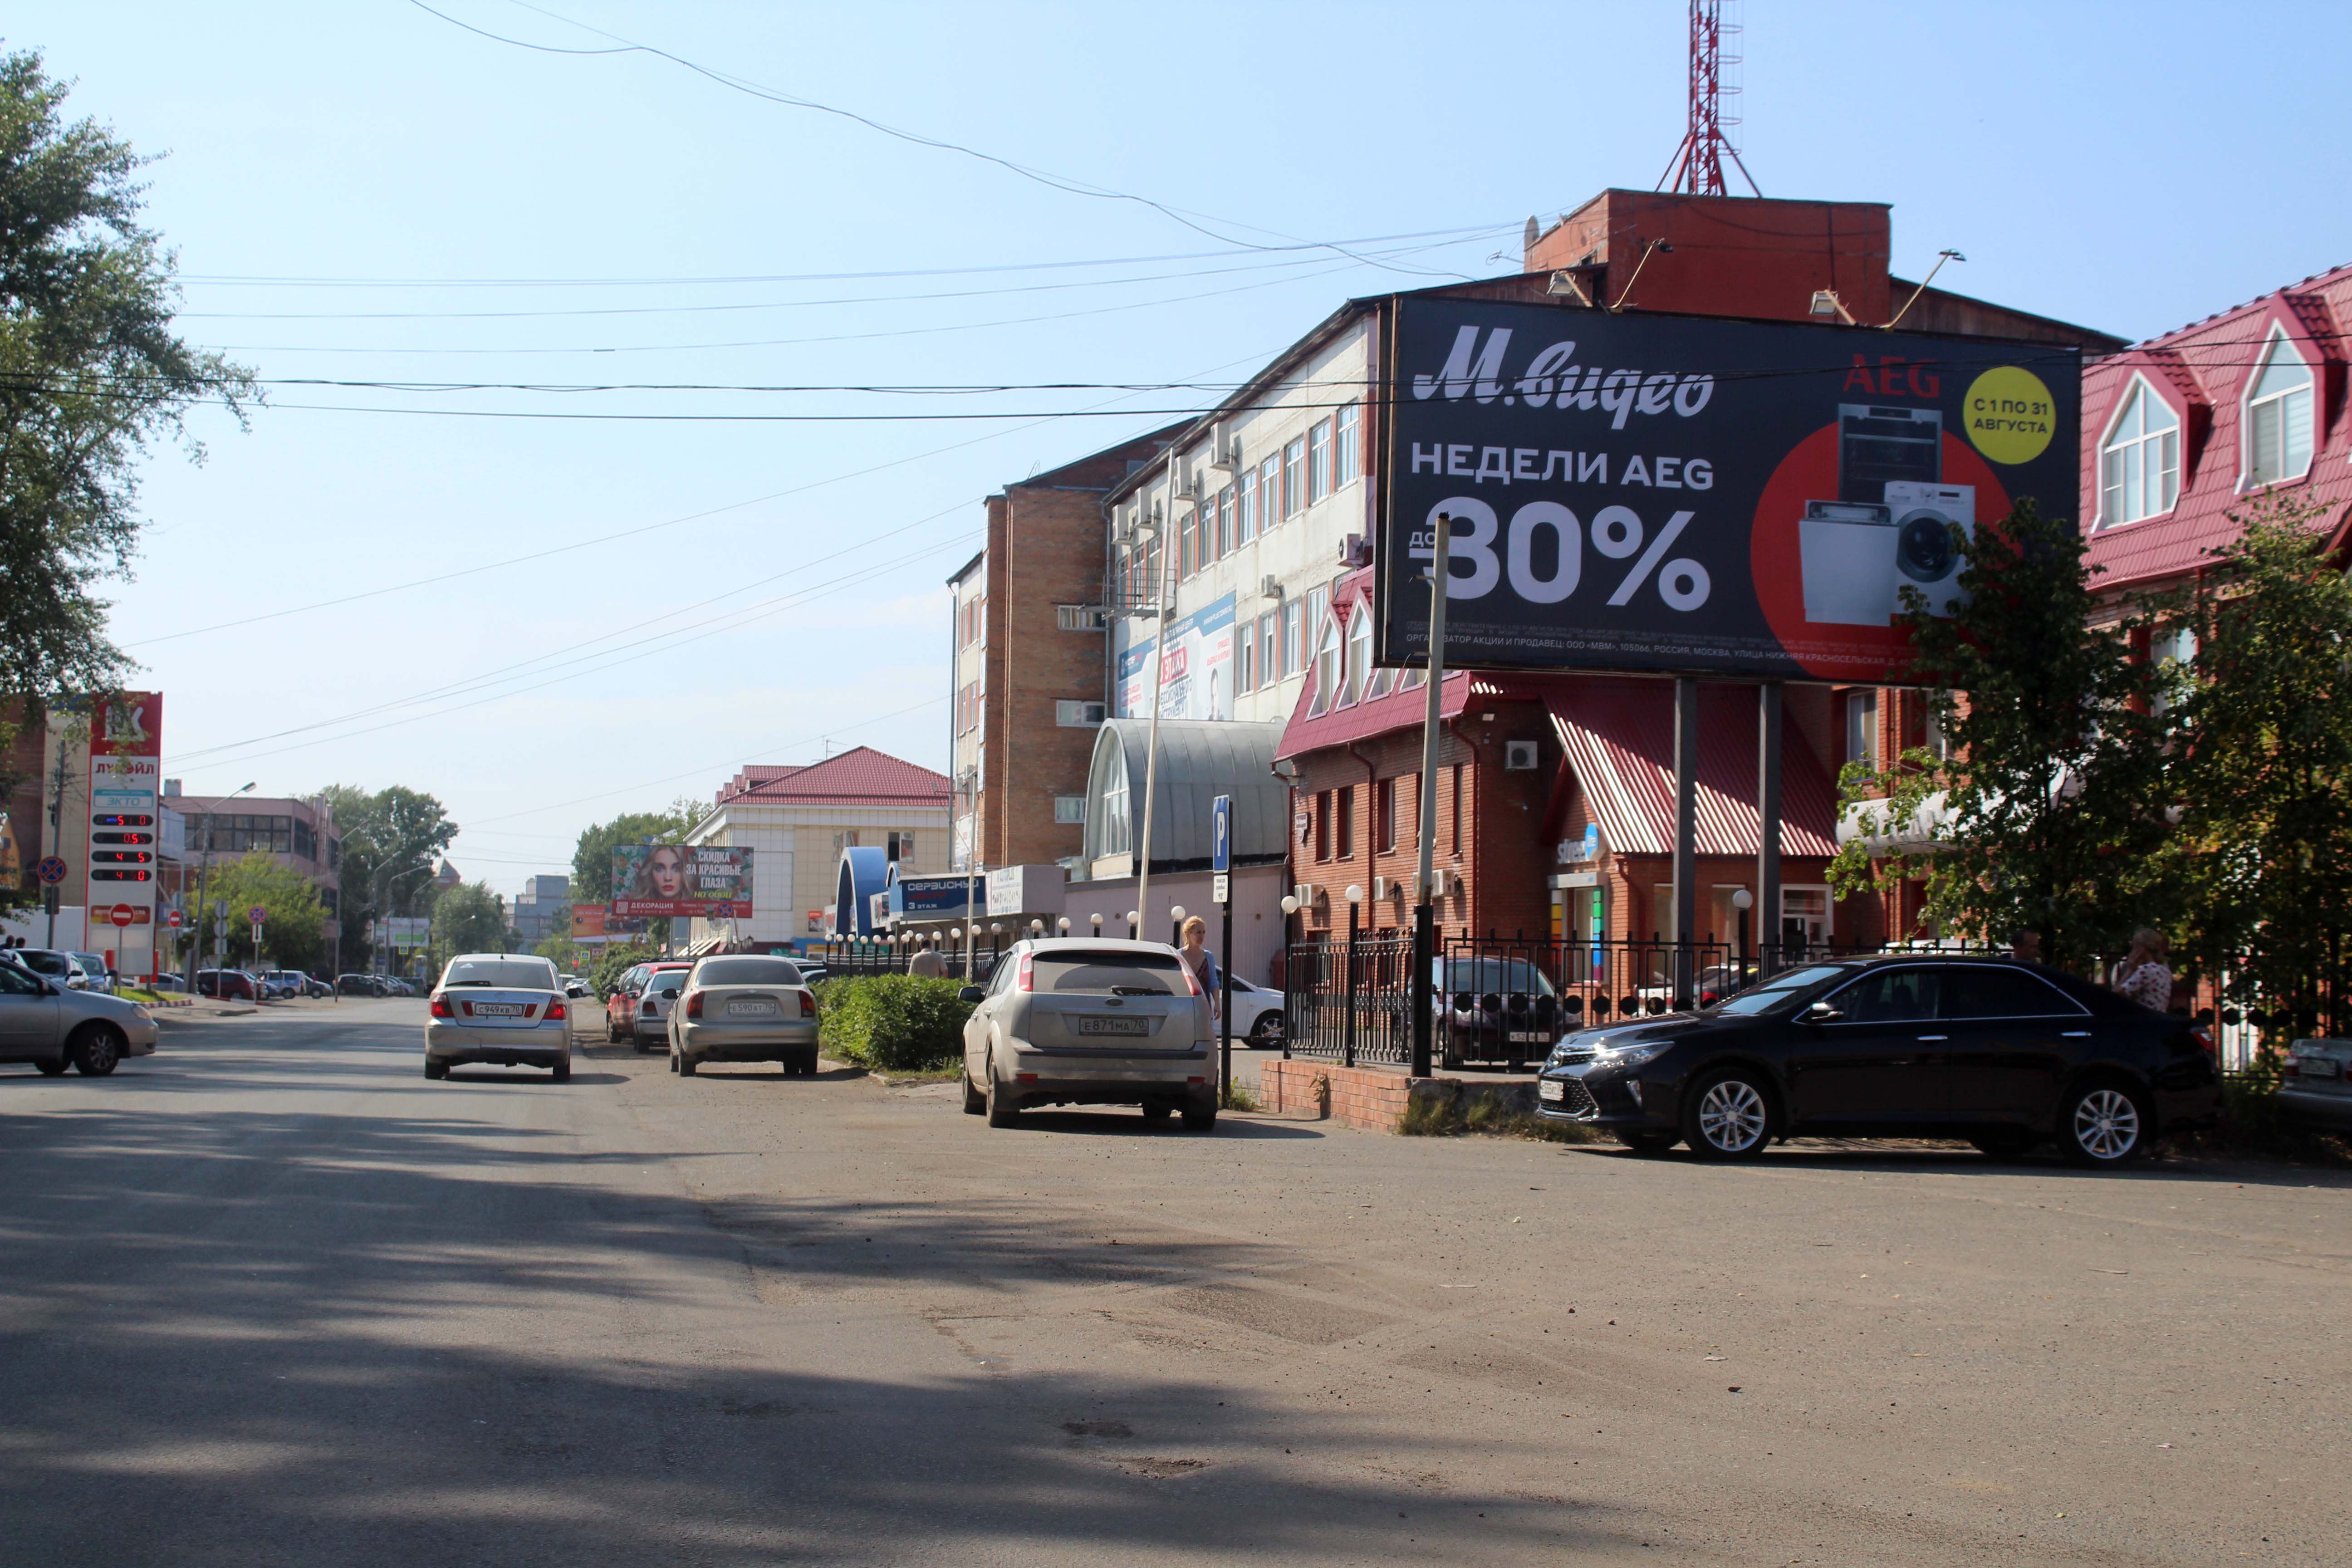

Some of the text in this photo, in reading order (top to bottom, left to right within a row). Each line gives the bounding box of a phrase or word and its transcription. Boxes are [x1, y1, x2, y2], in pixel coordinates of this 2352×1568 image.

[1842, 353, 1940, 398] AEG
[1974, 398, 2048, 416] С 1 ПО 31
[1974, 418, 2048, 435] АВГУСТА
[1412, 442, 1714, 490] НЕДЕЛИ AEG
[1423, 496, 1711, 612] 30%
[1406, 634, 1470, 643] ОРГАЗАТОР
[1473, 636, 1503, 646] АКЦИИ
[1514, 638, 1564, 648] ПРОДАВЕЦ:
[1566, 640, 1585, 649] ООО
[1654, 645, 1691, 655] РОССИЯ,
[1694, 647, 1731, 657] МОСКВА,
[1735, 649, 1763, 658] УЛИЦА
[107, 797, 140, 806] ЭКТО
[1217, 812, 1225, 857] P
[698, 851, 730, 863] СКИДКА
[686, 864, 742, 876] ЗА КРАСИВЫЕ
[701, 877, 726, 888] ГЛАЗА
[708, 889, 732, 898] обои
[909, 892, 947, 901] ЦЕНТР
